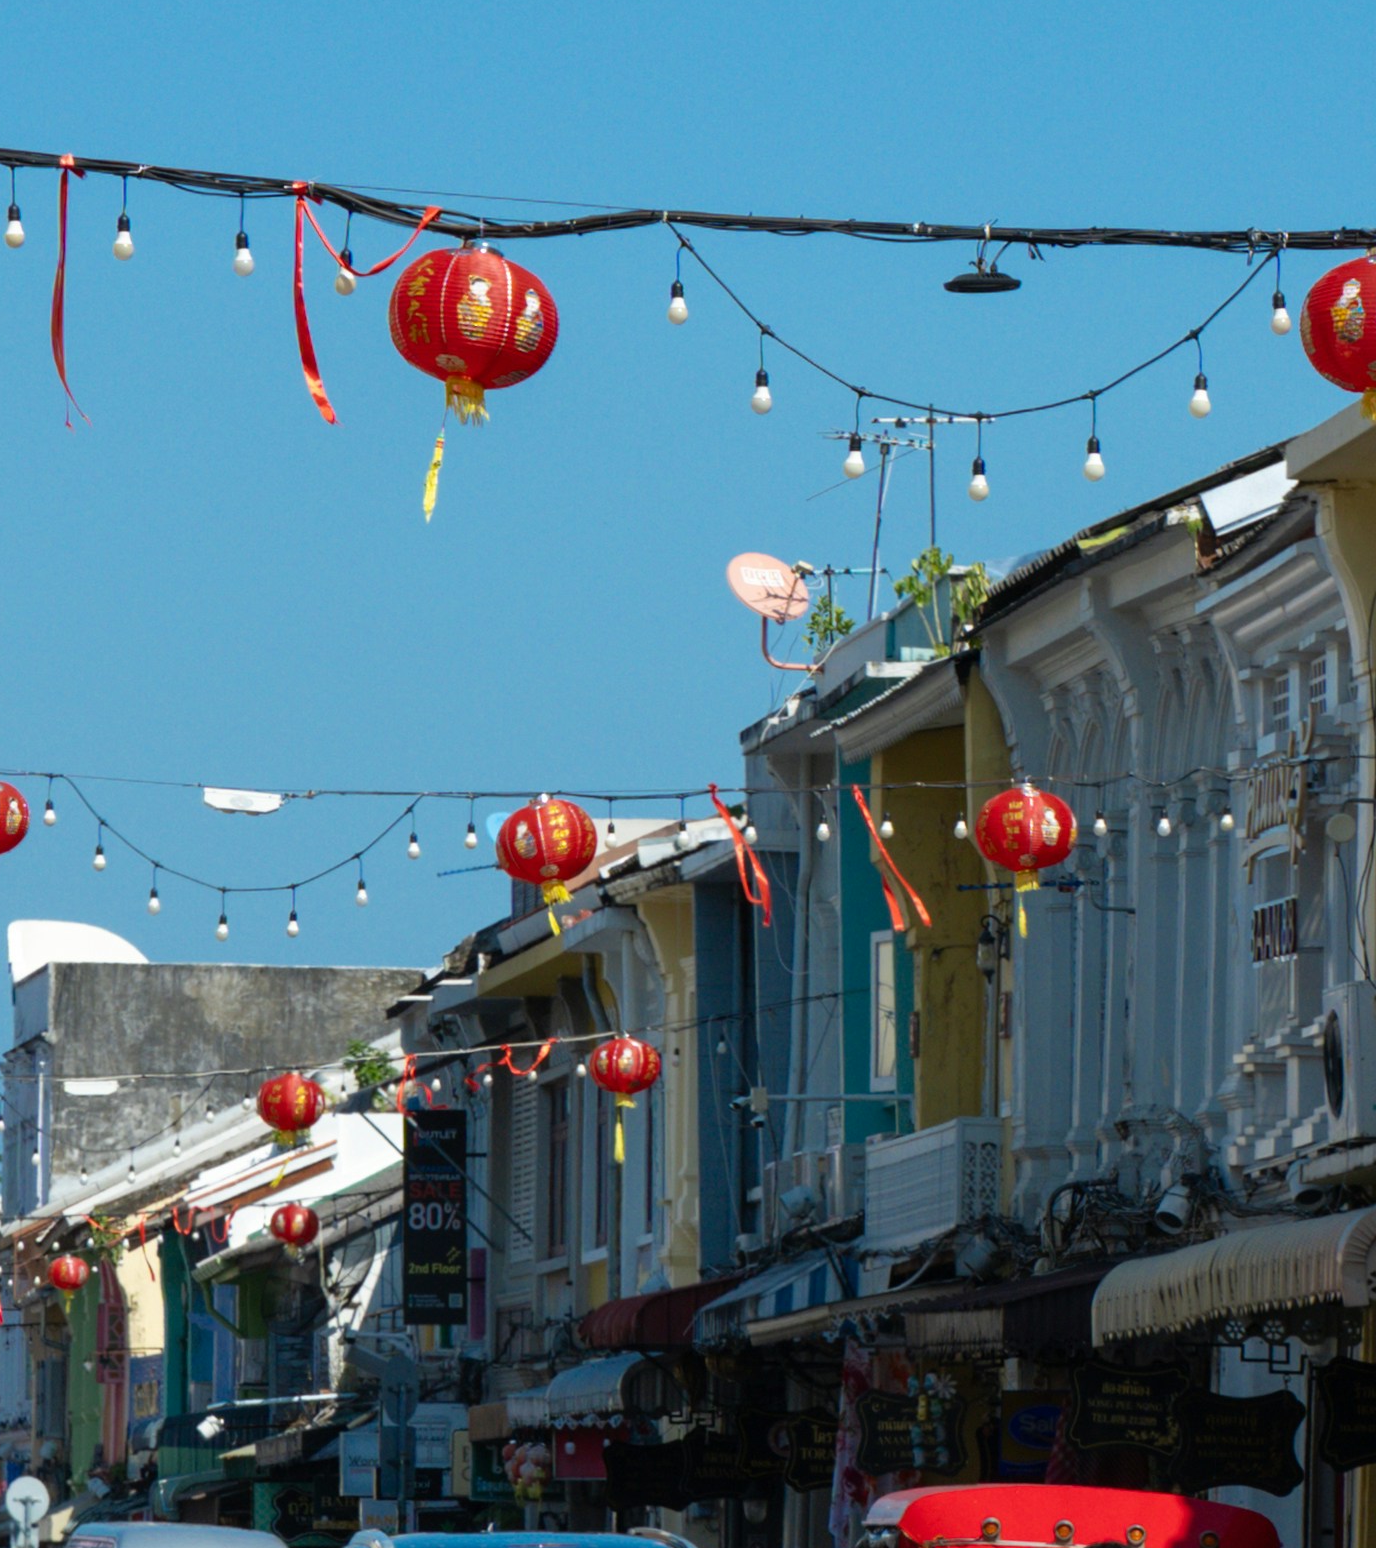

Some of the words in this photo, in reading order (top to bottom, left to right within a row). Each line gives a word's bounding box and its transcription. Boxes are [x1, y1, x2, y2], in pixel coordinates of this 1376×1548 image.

[408, 1202, 462, 1231] 80%
[408, 1262, 429, 1275] 2nd
[432, 1262, 462, 1275] Floor
